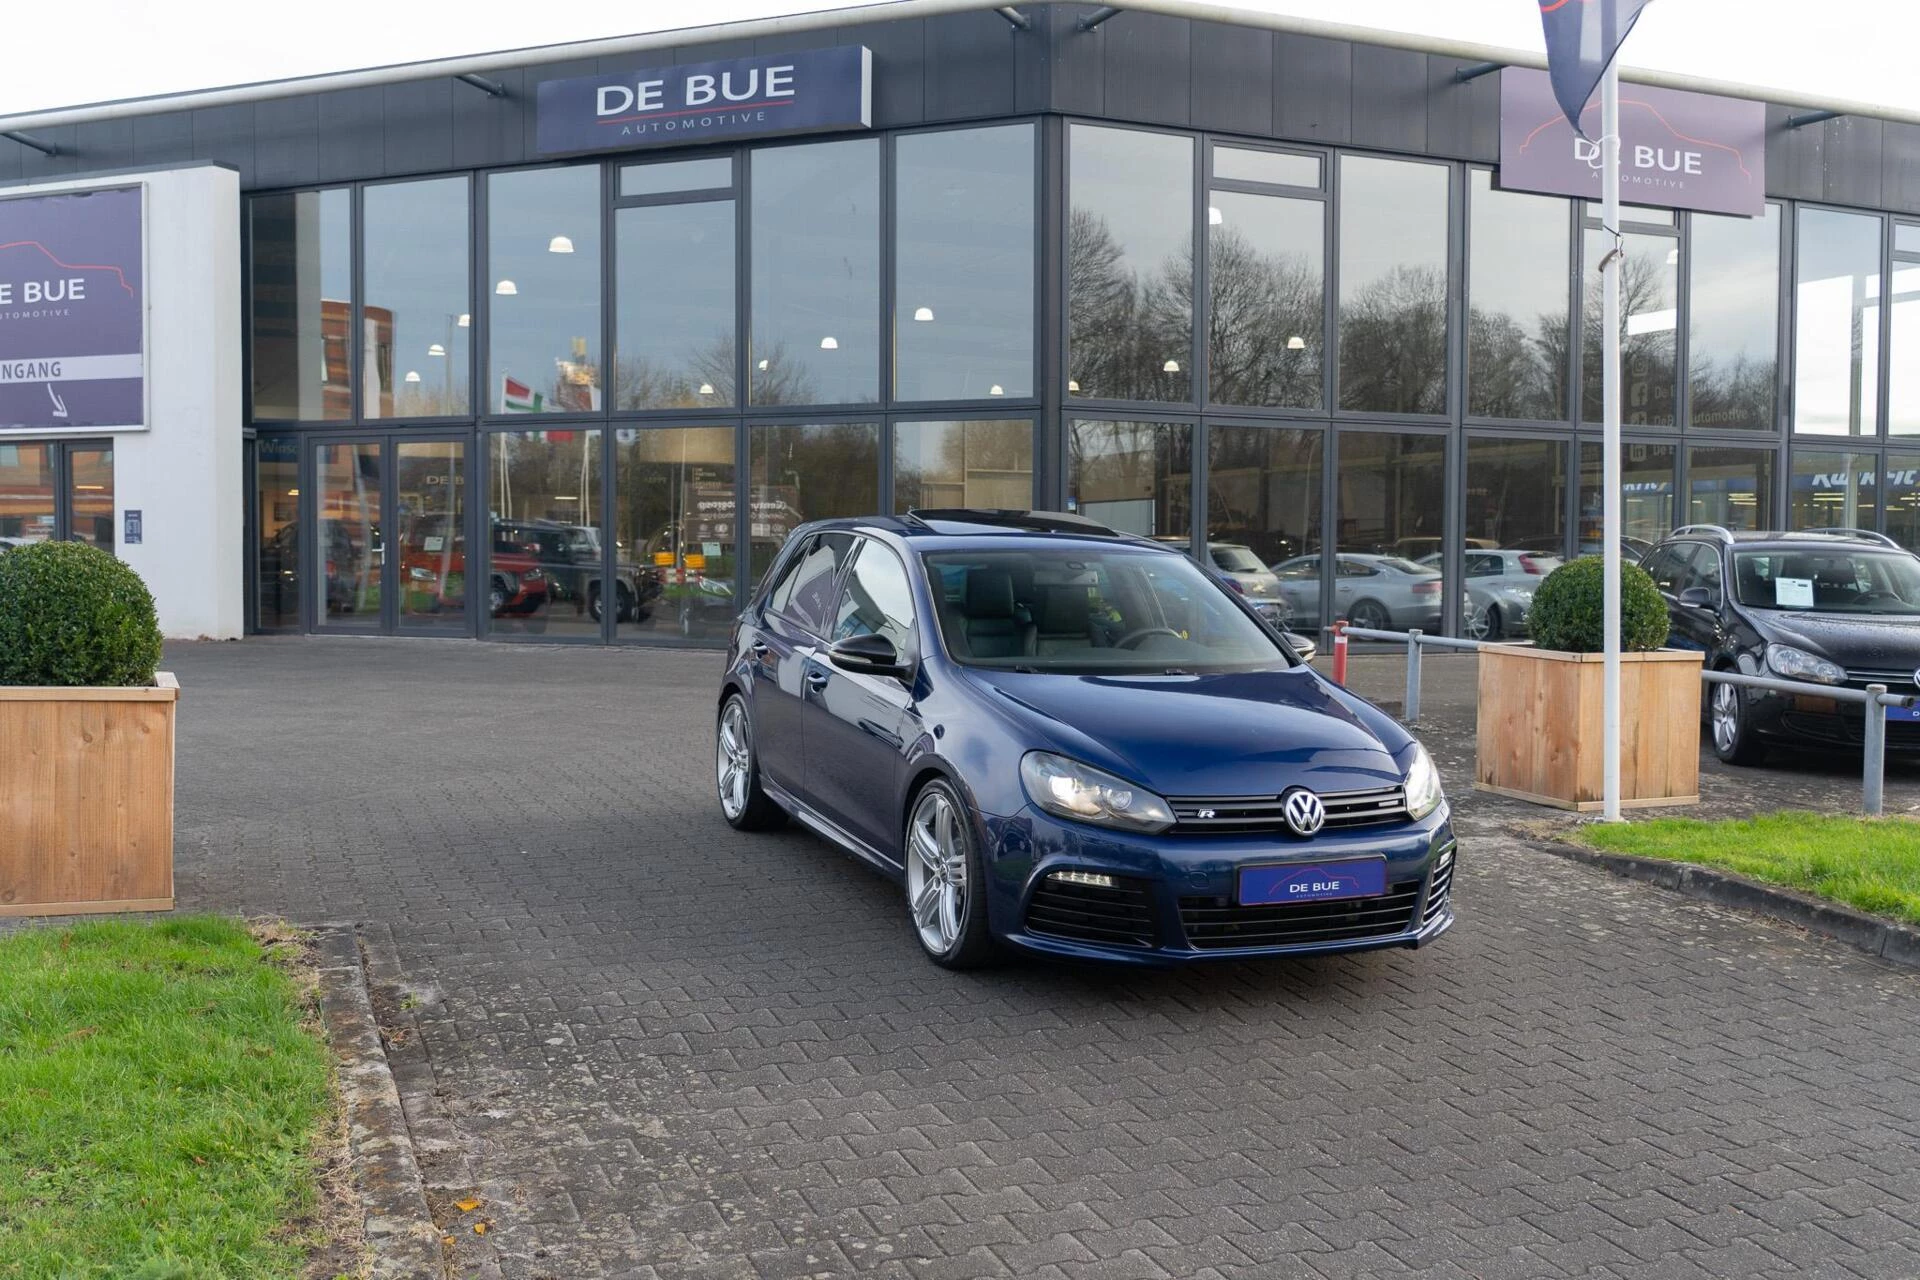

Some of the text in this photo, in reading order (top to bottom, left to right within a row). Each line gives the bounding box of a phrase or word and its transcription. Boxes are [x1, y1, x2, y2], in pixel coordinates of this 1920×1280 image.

[597, 65, 795, 116] DE BUE
[622, 111, 765, 136] AUTOMOTIVE
[1635, 145, 1702, 175] BUE
[1592, 171, 1684, 188] AOMOTIVE
[0, 278, 85, 305] E BUE
[0, 309, 69, 319] TOMOTIVE
[2, 361, 61, 379] NGANG
[1289, 881, 1340, 893] DE BUE
